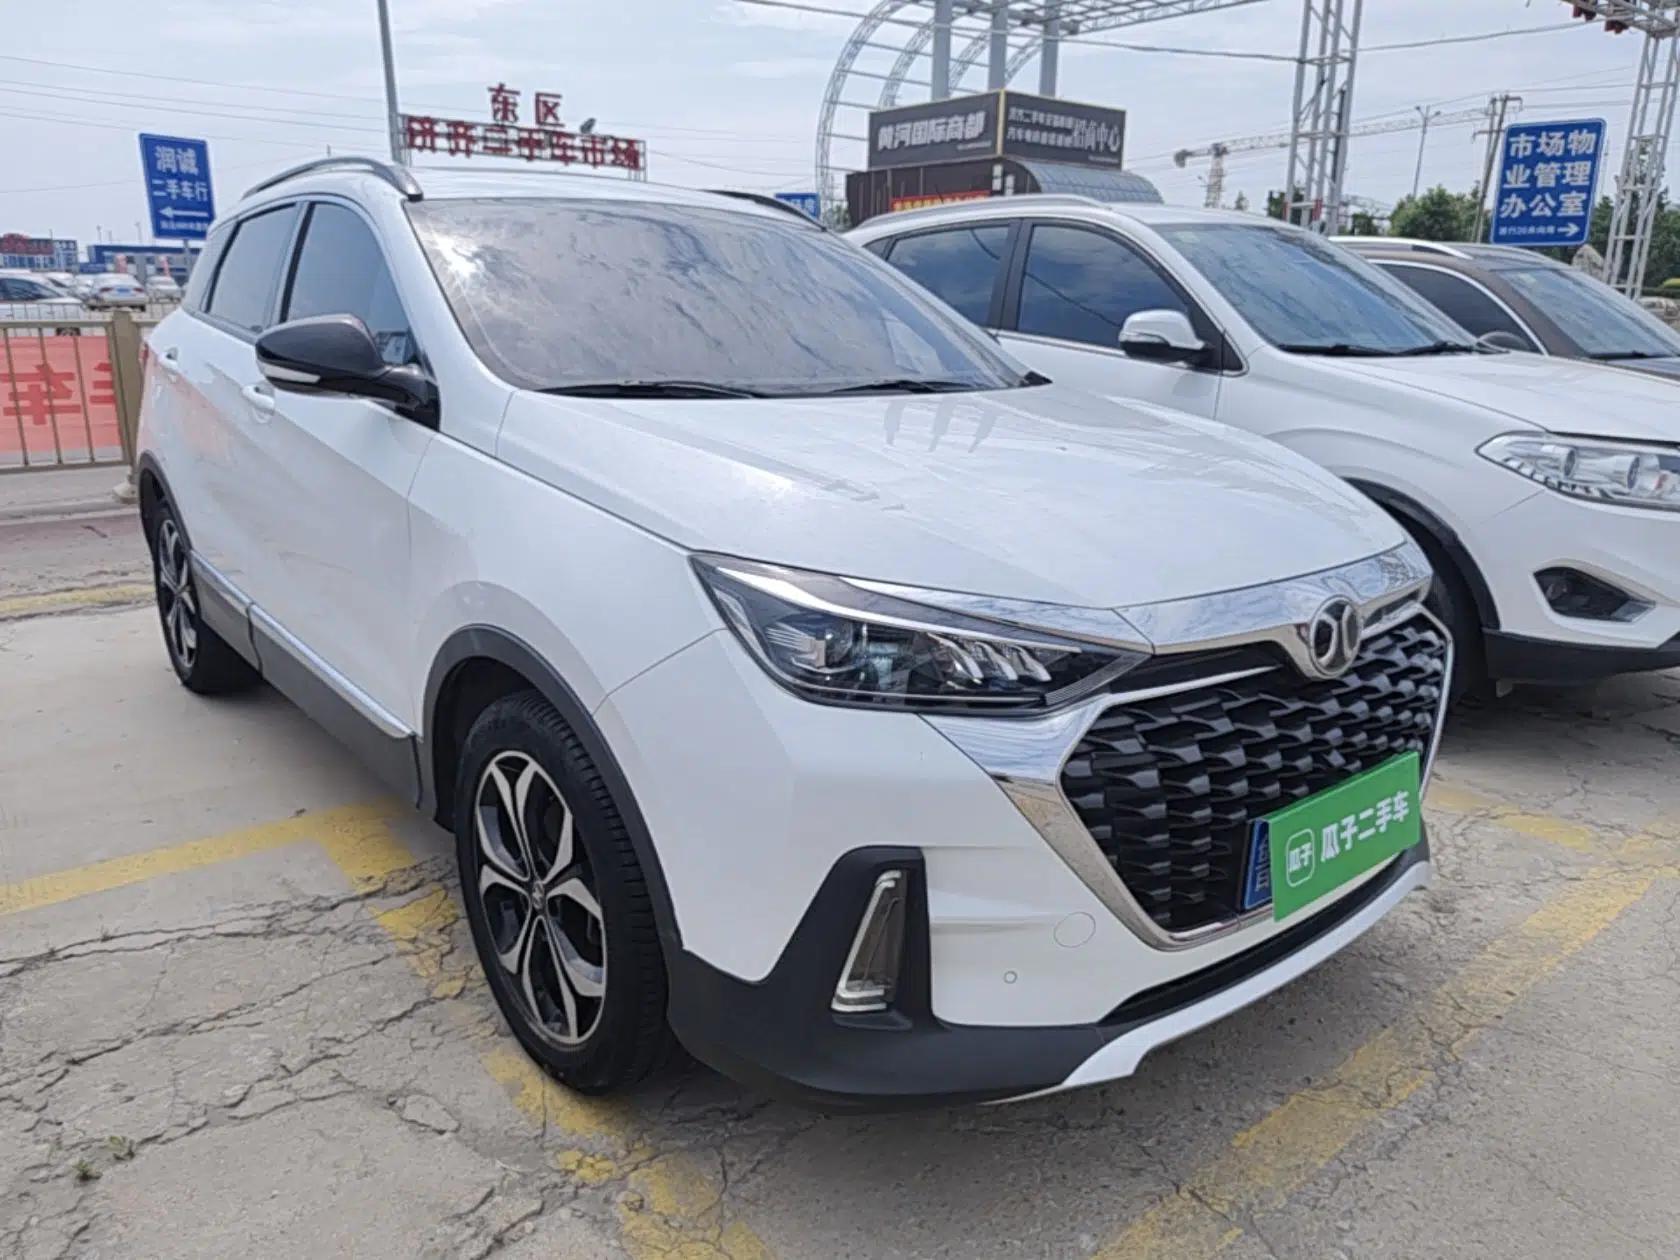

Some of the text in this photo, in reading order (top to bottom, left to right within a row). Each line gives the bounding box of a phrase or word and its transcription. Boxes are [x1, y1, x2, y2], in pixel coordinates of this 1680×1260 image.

[488, 83, 565, 127] 东区
[1508, 129, 1597, 158] 市场物
[1503, 161, 1592, 188] 业管理
[152, 179, 209, 201] 二手车行
[1500, 191, 1587, 218] 办公室
[1321, 791, 1409, 862] 瓜子二手车
[1289, 842, 1313, 872] 瓜子
